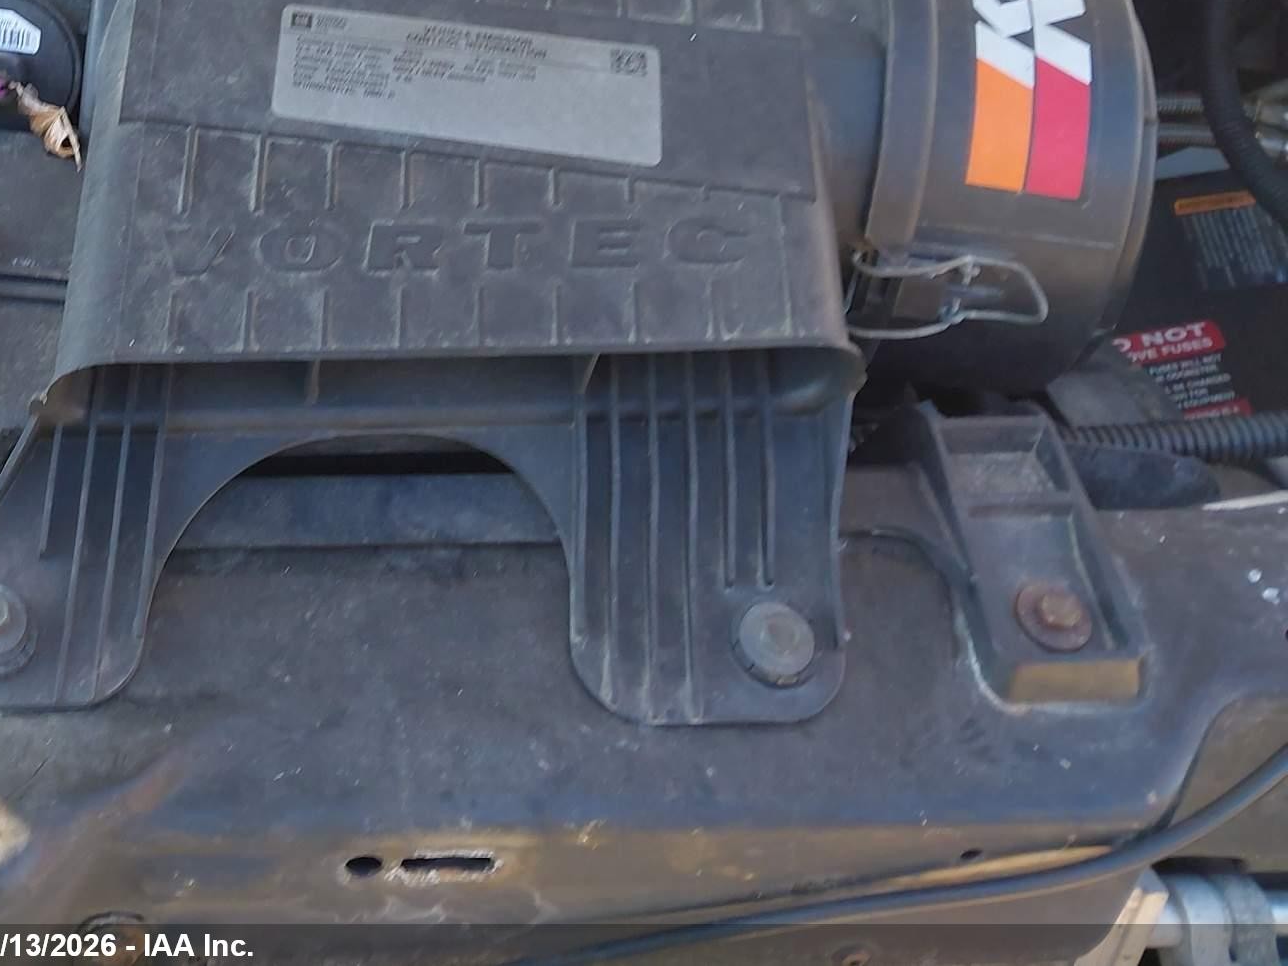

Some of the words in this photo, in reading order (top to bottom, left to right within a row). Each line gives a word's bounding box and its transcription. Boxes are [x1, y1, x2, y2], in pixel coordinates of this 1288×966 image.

[165, 216, 750, 276] VORTEC
[1141, 321, 1207, 348] NOT
[1161, 337, 1214, 356] FUSES
